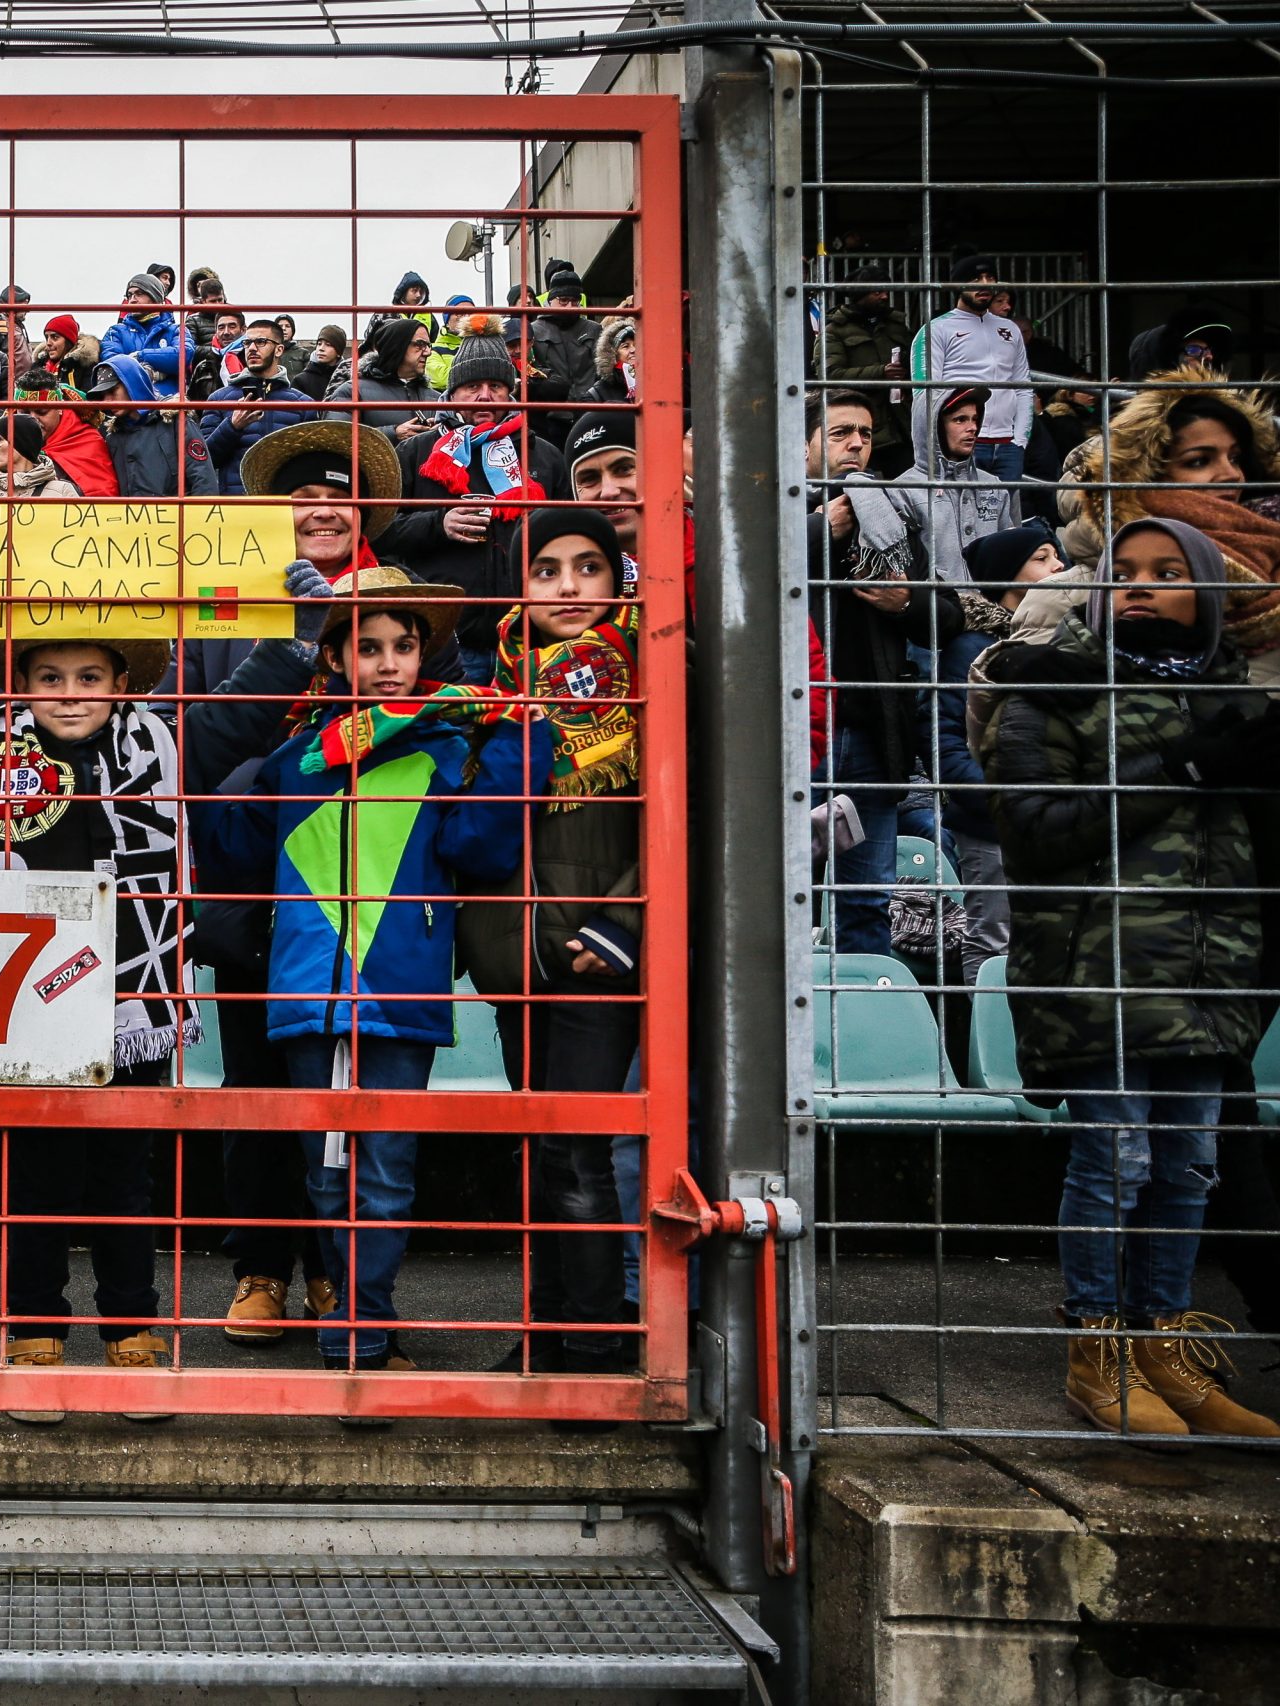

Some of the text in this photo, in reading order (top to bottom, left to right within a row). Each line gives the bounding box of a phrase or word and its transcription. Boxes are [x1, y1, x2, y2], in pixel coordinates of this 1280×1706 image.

[205, 501, 224, 524] A
[194, 624, 239, 632] PORTUGAL
[552, 714, 638, 762] PORTUGA
[38, 962, 81, 999] F-SIDE
